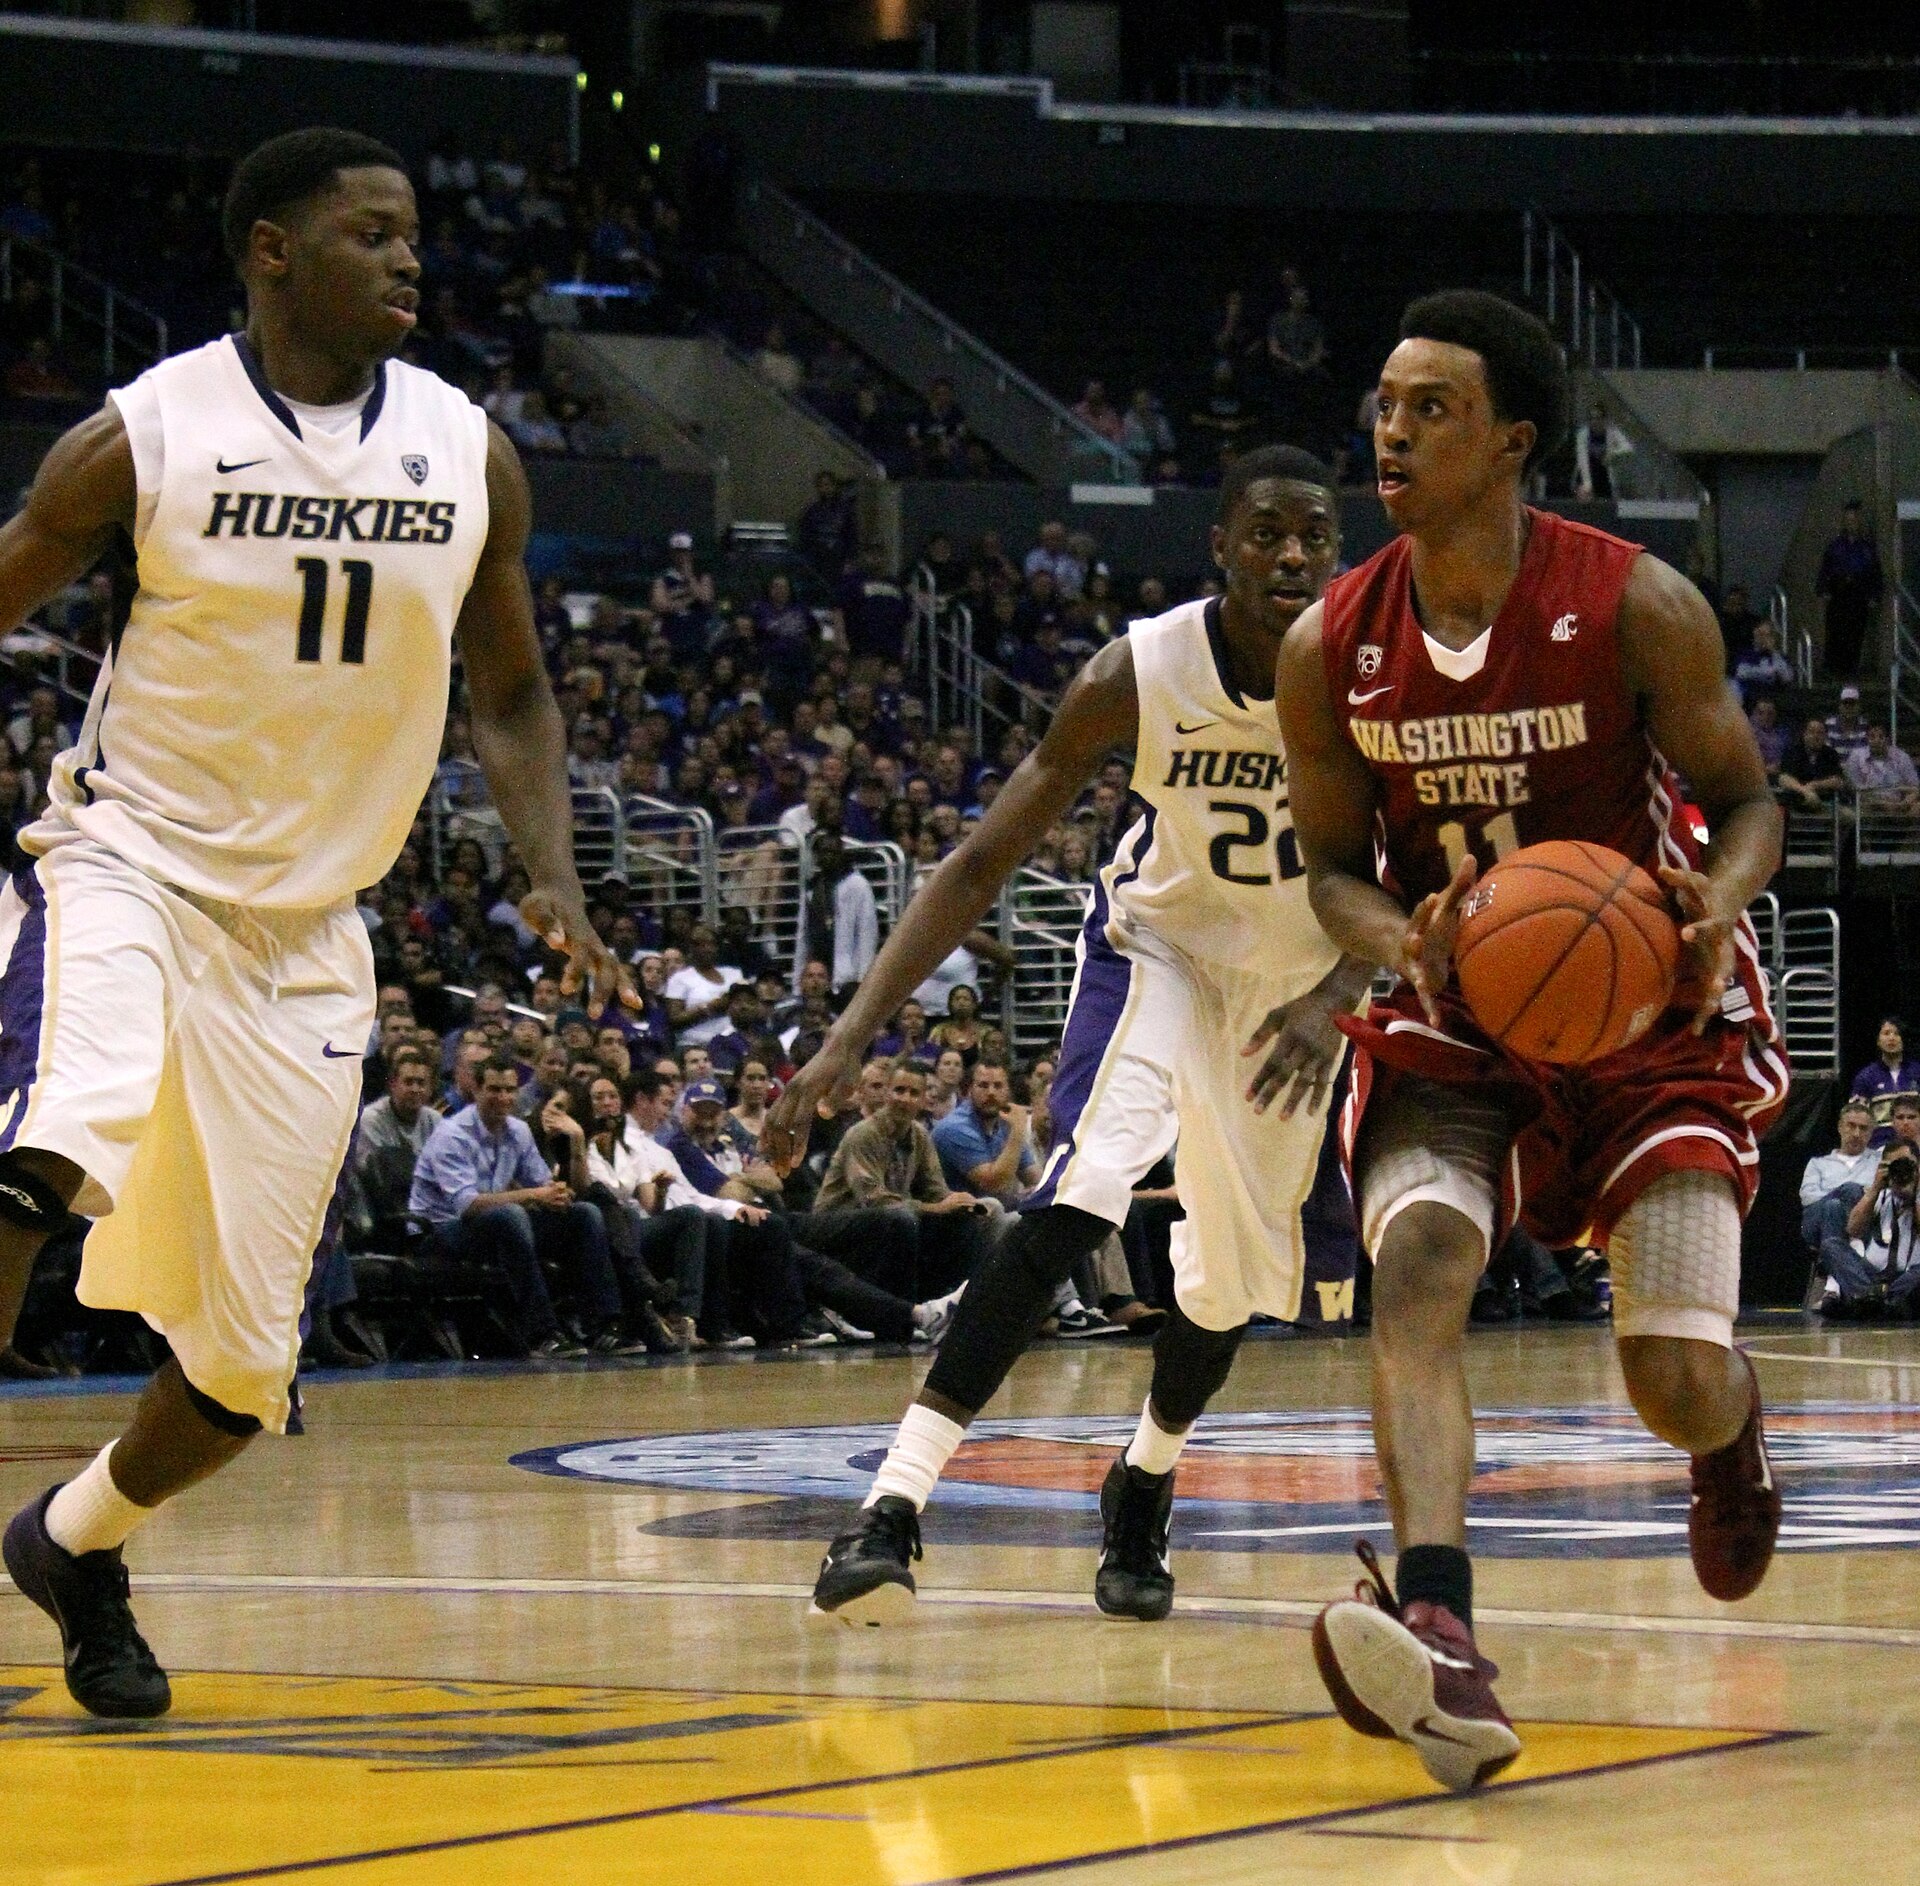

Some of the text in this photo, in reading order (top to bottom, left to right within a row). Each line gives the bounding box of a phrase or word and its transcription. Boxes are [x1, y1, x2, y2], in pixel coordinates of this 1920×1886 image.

[202, 492, 457, 544] HUSKIES
[295, 556, 374, 665] 11
[1349, 701, 1589, 764] WASHINGTON
[1414, 761, 1531, 806] STATE
[1438, 811, 1520, 882] 11
